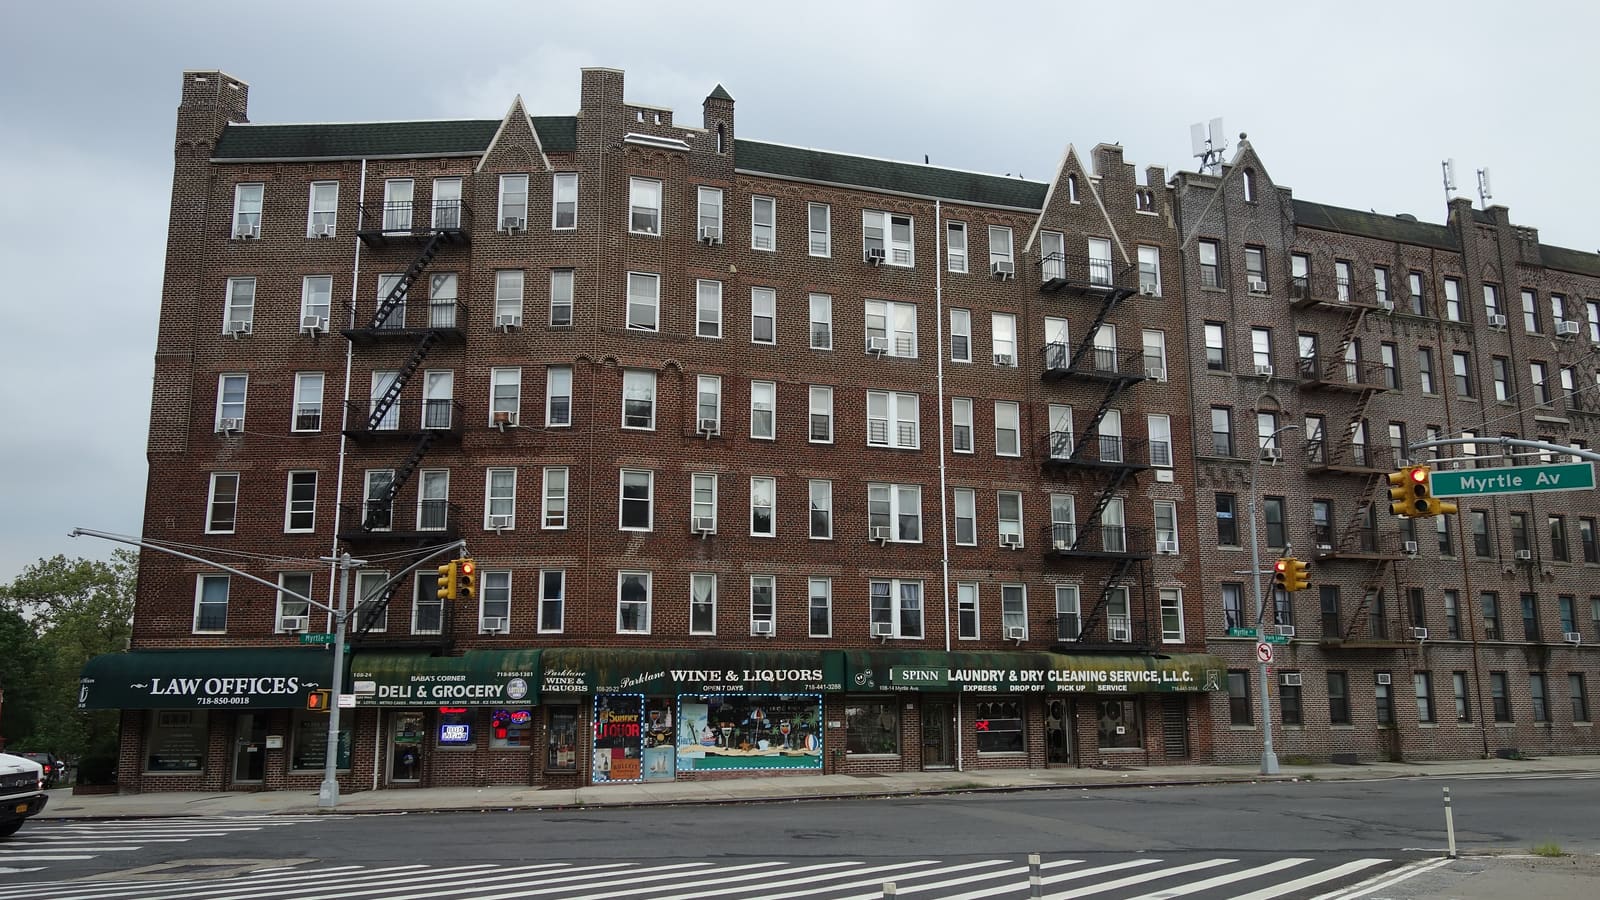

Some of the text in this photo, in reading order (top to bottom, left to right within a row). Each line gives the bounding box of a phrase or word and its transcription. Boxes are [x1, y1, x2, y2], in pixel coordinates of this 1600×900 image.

[1460, 473, 1560, 492] Myrtle Av
[1233, 628, 1248, 636] Myrtle
[305, 635, 325, 643] Myrtle
[620, 671, 665, 688] Parklane
[670, 669, 823, 682] WINE & LIQUORS
[902, 670, 938, 681] SPINN
[947, 669, 1194, 684] LAUNDRY & DRY CLEANING SERVICE, L.L.C.
[150, 677, 299, 695] LAW OFFICES
[378, 684, 504, 698] DELI & GROCERY
[197, 697, 250, 705] 718-850-0018
